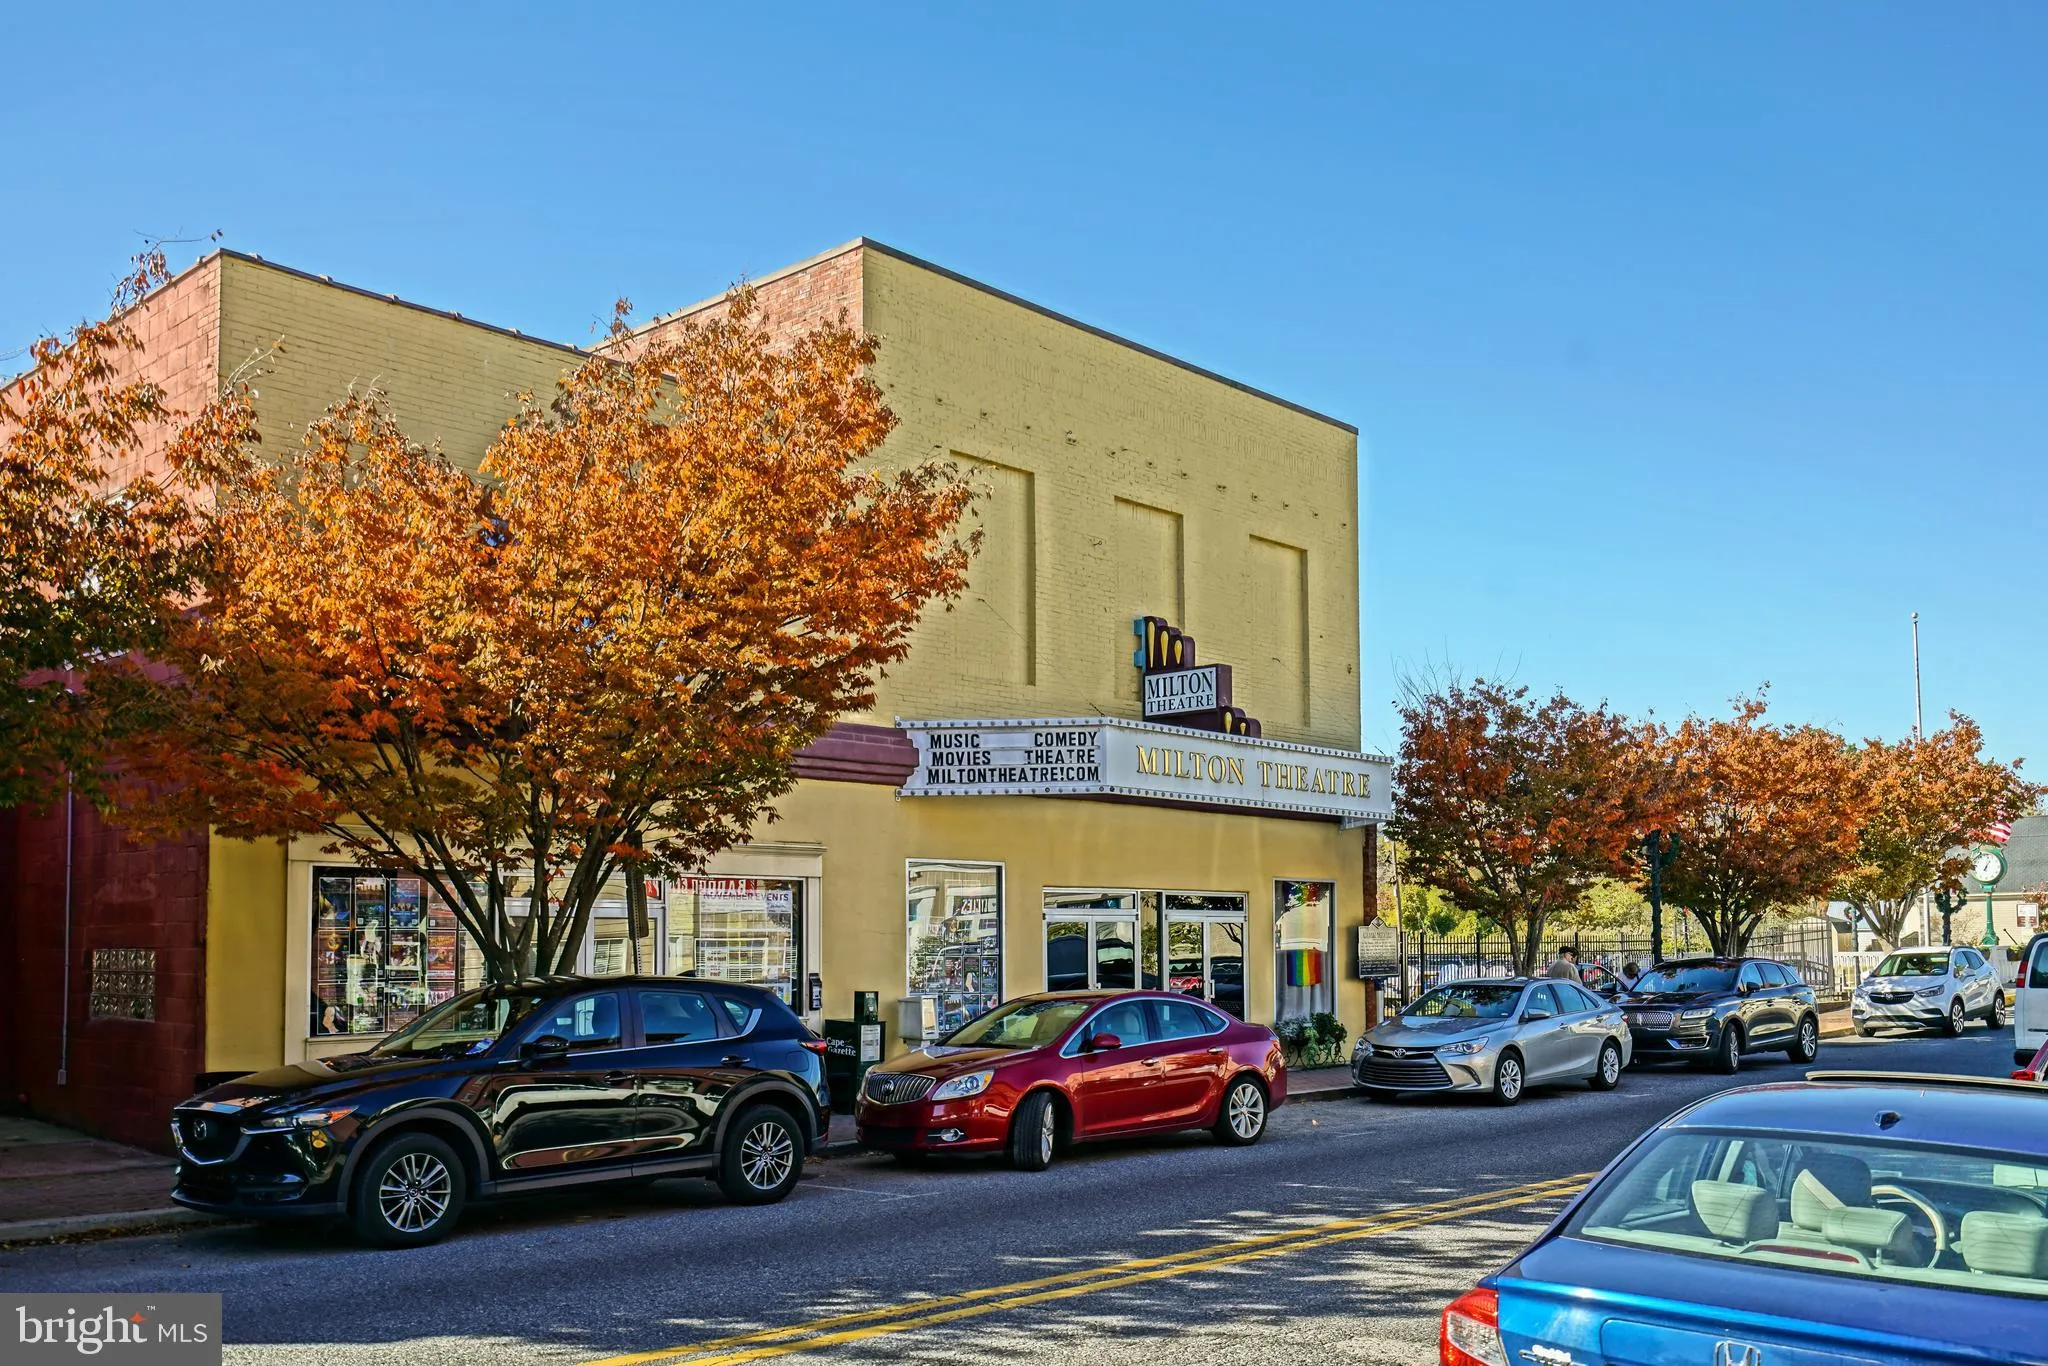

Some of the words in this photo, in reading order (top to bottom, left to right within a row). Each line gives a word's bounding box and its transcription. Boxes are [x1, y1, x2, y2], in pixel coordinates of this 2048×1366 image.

[1147, 671, 1213, 699] MILTON
[1147, 694, 1213, 712] THEATRE
[930, 734, 980, 749] MUSIC
[1034, 732, 1098, 747] COMEDY
[932, 750, 991, 766] MOVIES
[1024, 749, 1096, 764] THEATRE
[1136, 744, 1245, 785] MILTON
[1256, 760, 1371, 798] THEATRE
[755, 892, 789, 901] EVENTS
[826, 1036, 845, 1048] Cape
[827, 1046, 857, 1057] Gazette
